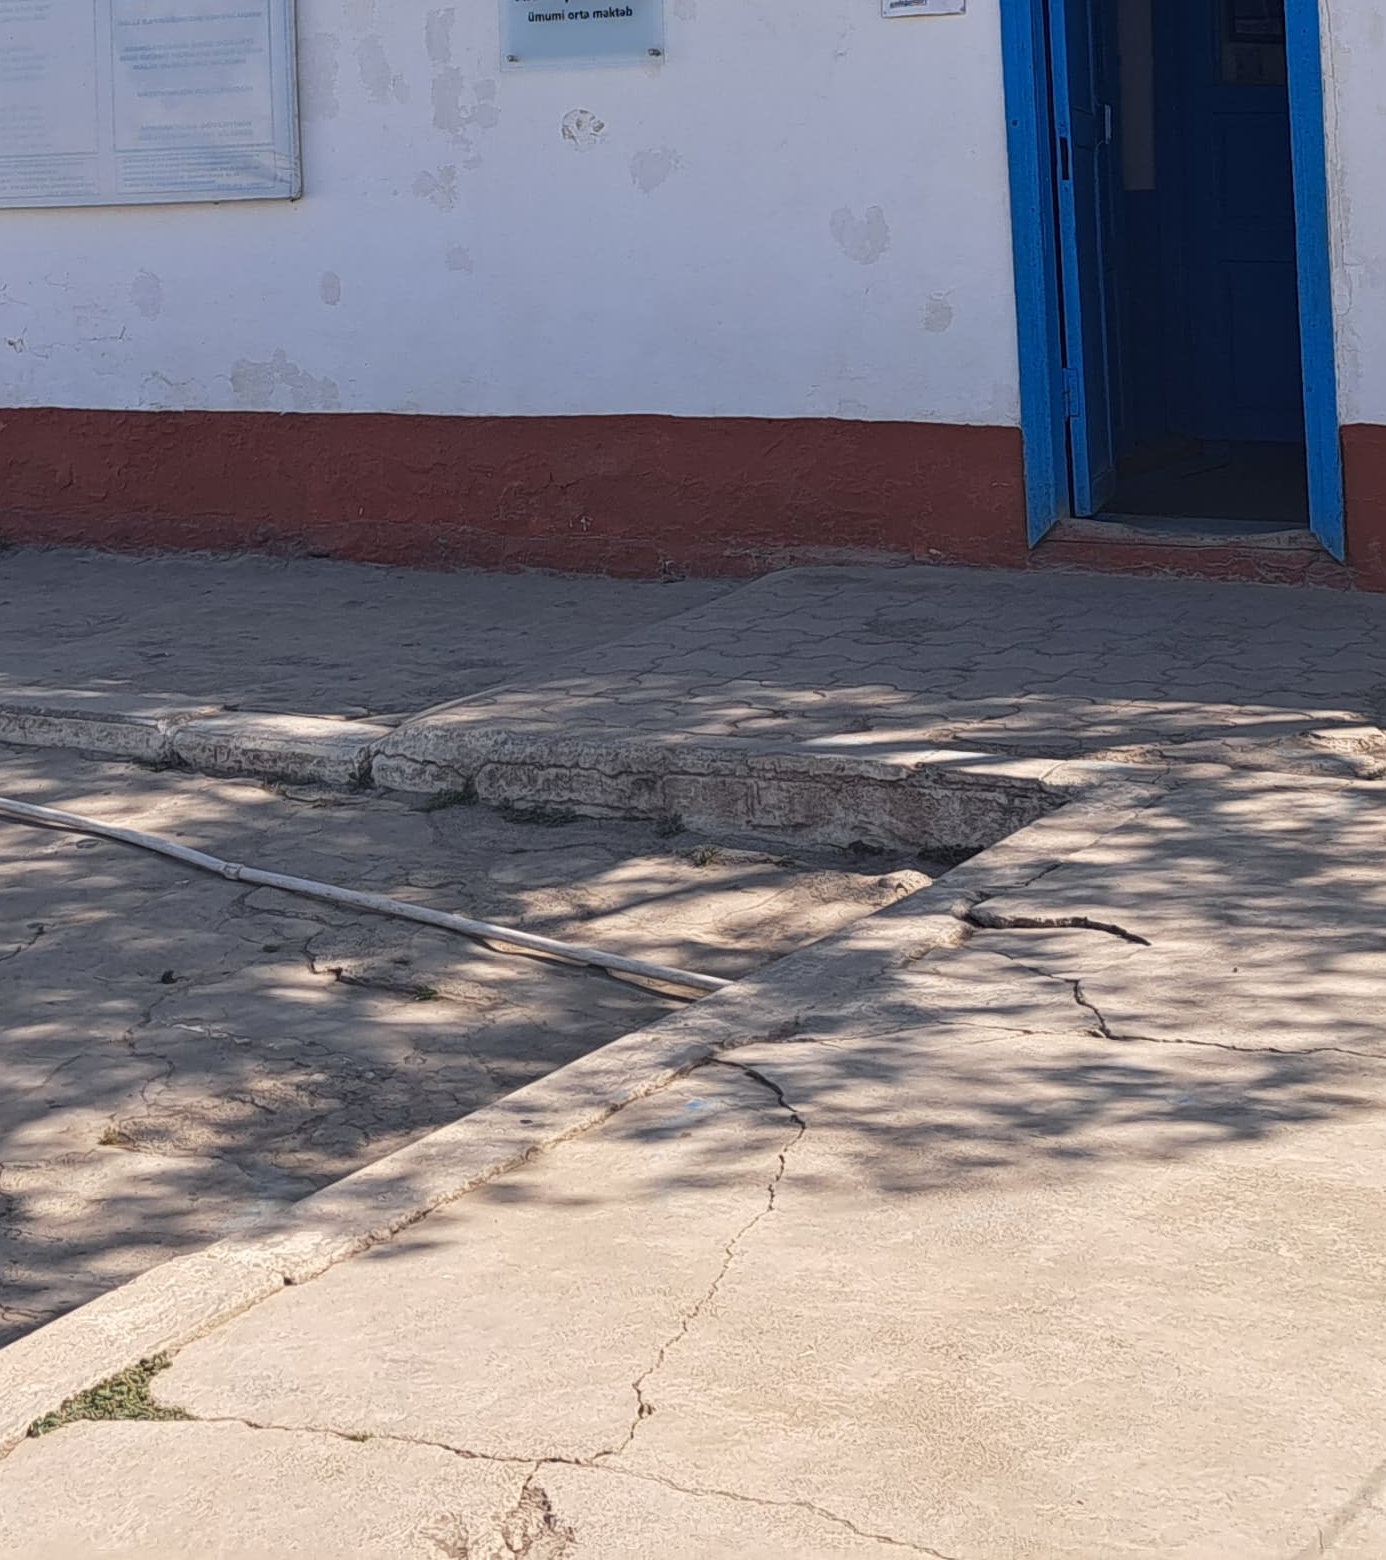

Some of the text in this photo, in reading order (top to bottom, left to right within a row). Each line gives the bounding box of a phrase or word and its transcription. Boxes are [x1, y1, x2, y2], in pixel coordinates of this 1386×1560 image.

[528, 5, 633, 22] ümumi orta məktəb
